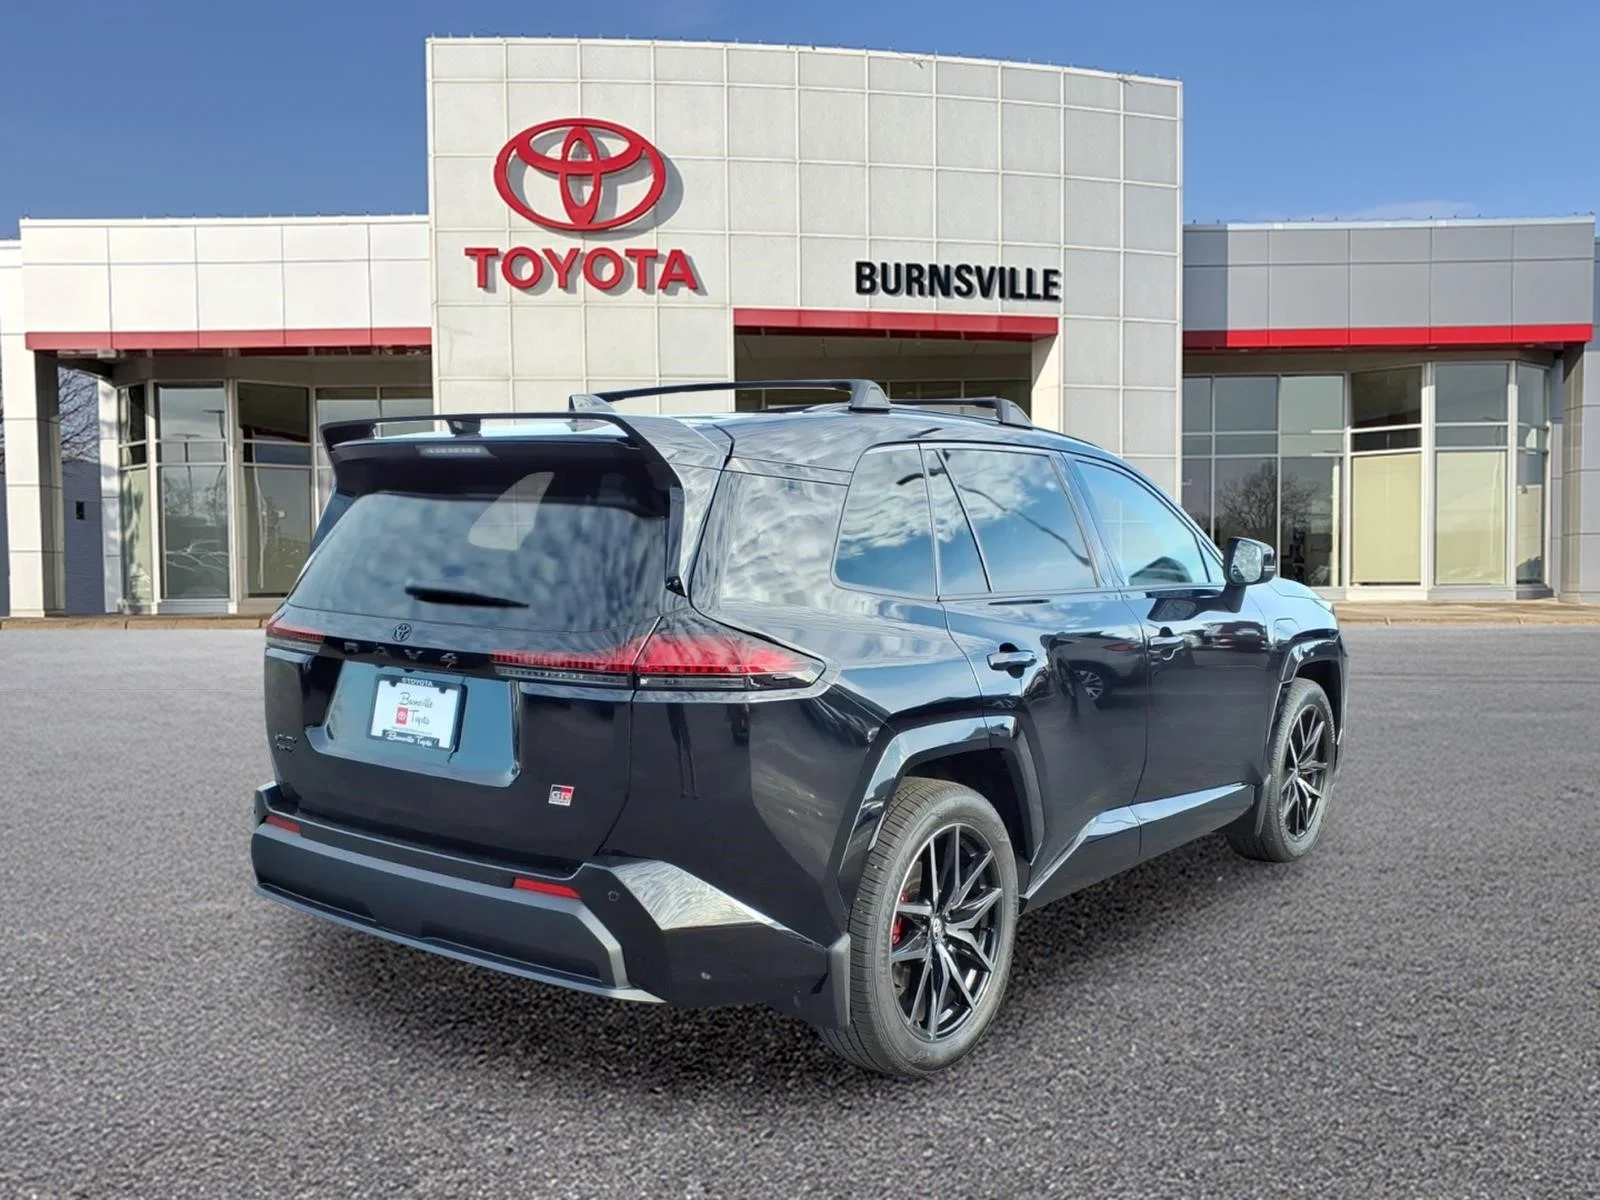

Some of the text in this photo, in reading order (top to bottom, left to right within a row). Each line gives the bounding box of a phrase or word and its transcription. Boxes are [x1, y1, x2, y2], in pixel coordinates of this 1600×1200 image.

[464, 246, 699, 290] TOYOTA
[855, 261, 1060, 301] BURNSVILLE
[407, 678, 433, 687] TOYOTA
